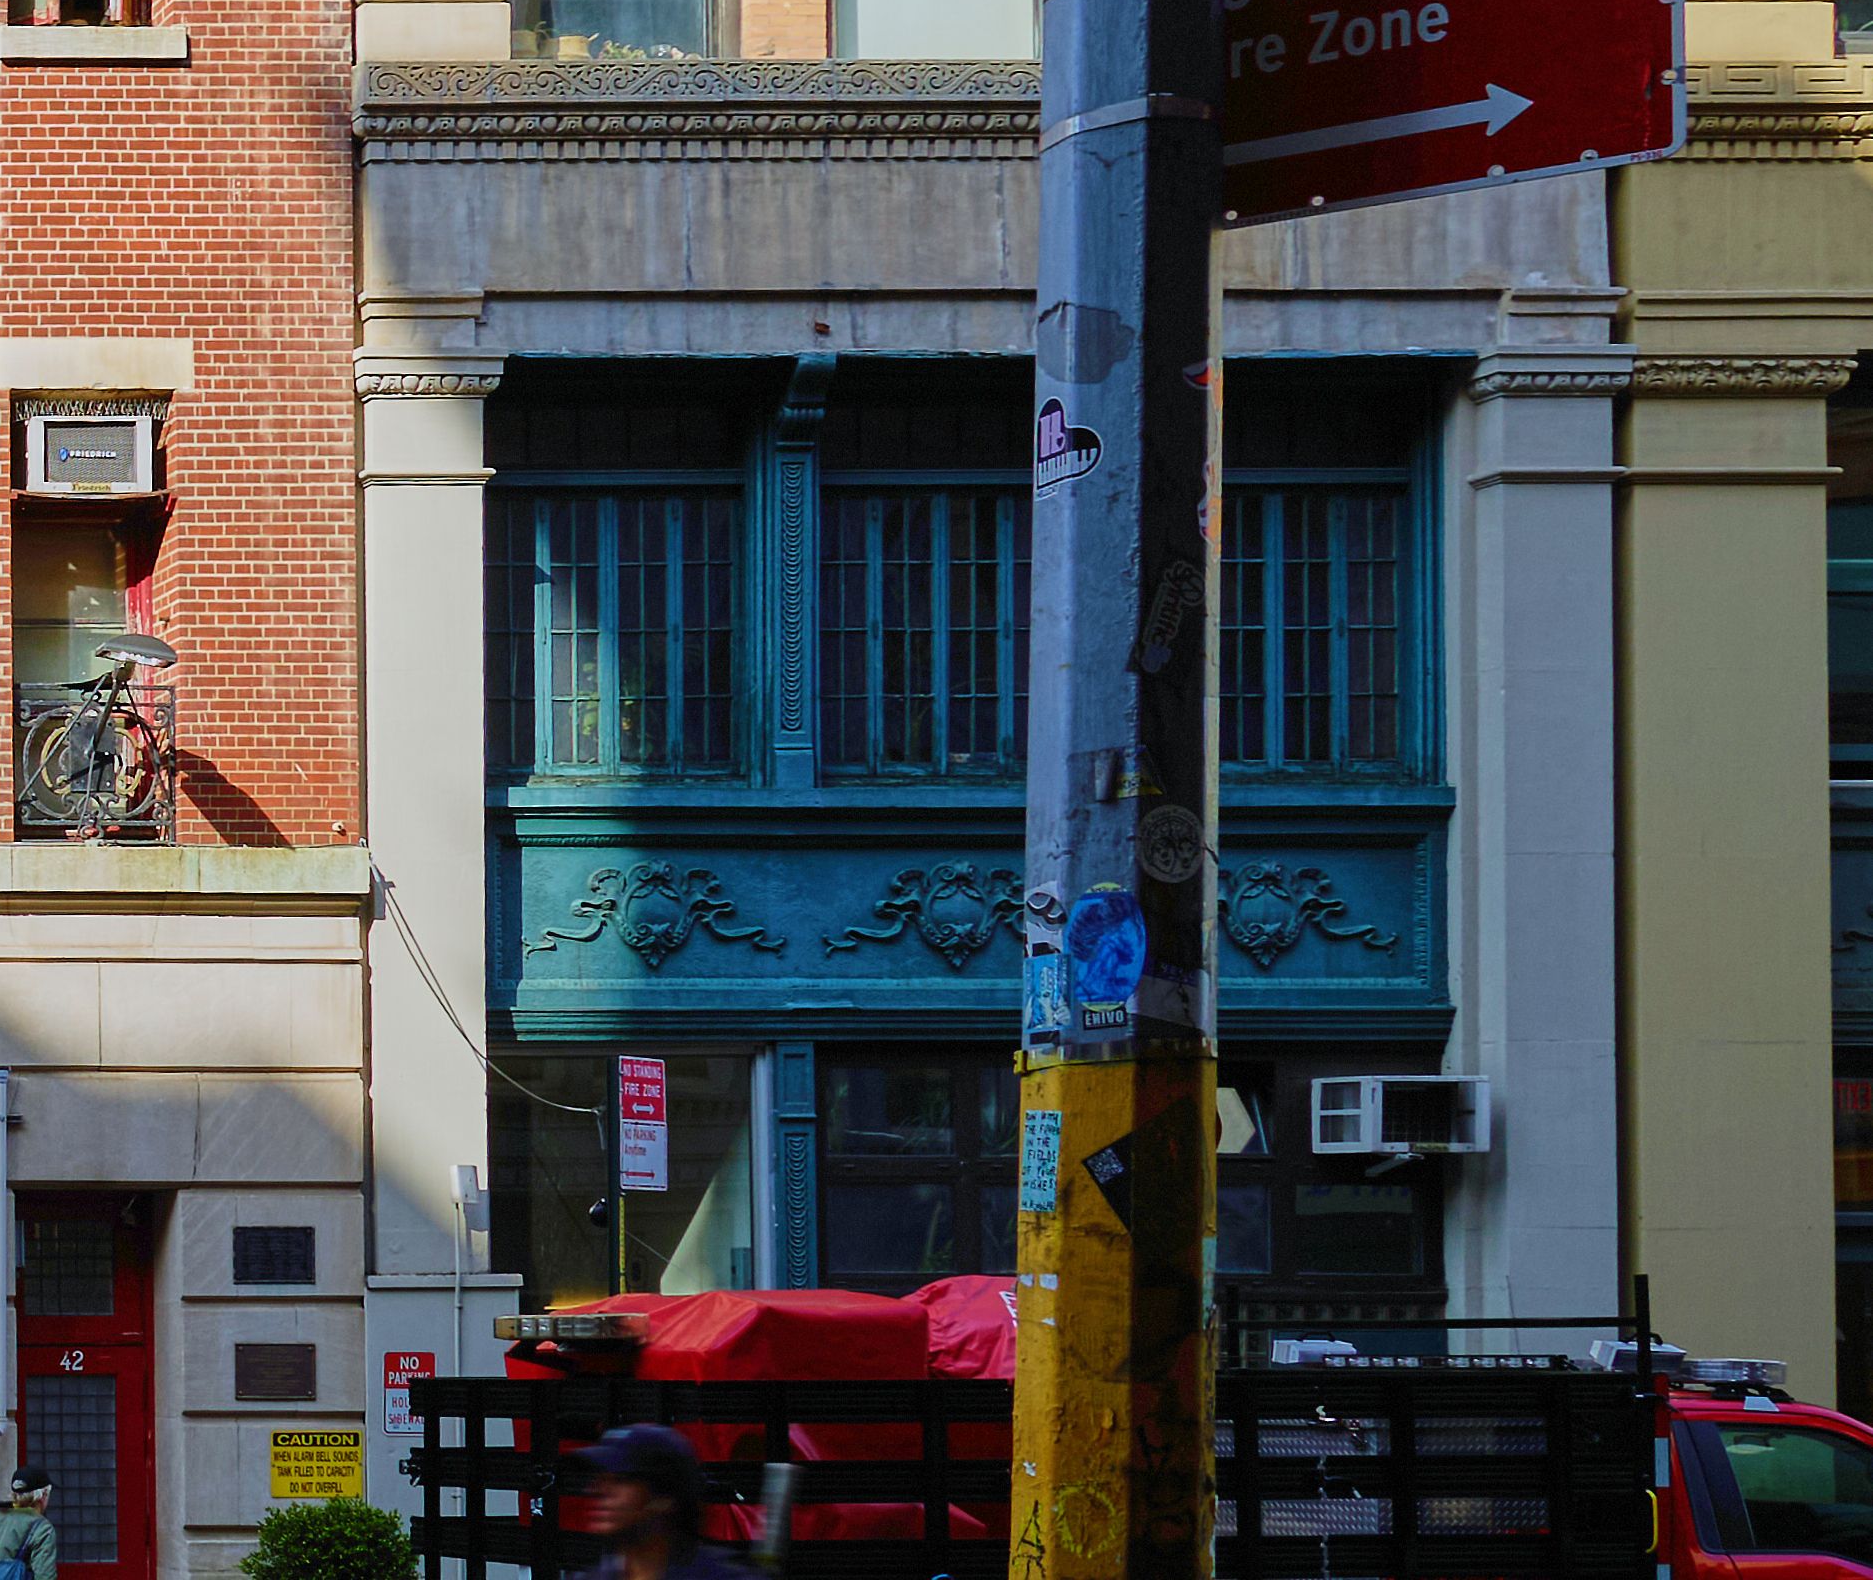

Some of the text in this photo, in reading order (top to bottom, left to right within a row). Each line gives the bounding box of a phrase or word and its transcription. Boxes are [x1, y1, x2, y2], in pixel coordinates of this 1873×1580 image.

[1230, 0, 1451, 80] re Zone
[642, 1083, 661, 1098] ZONE
[60, 1349, 84, 1371] 42
[400, 1356, 420, 1370] NO
[277, 1433, 354, 1446] CAUTION
[273, 1450, 359, 1462] WHEN ALARM BELL SOUNDS
[276, 1466, 356, 1477] TANK FILLED TO CAPACITY
[289, 1482, 343, 1493] DO NOT OVERFILL
